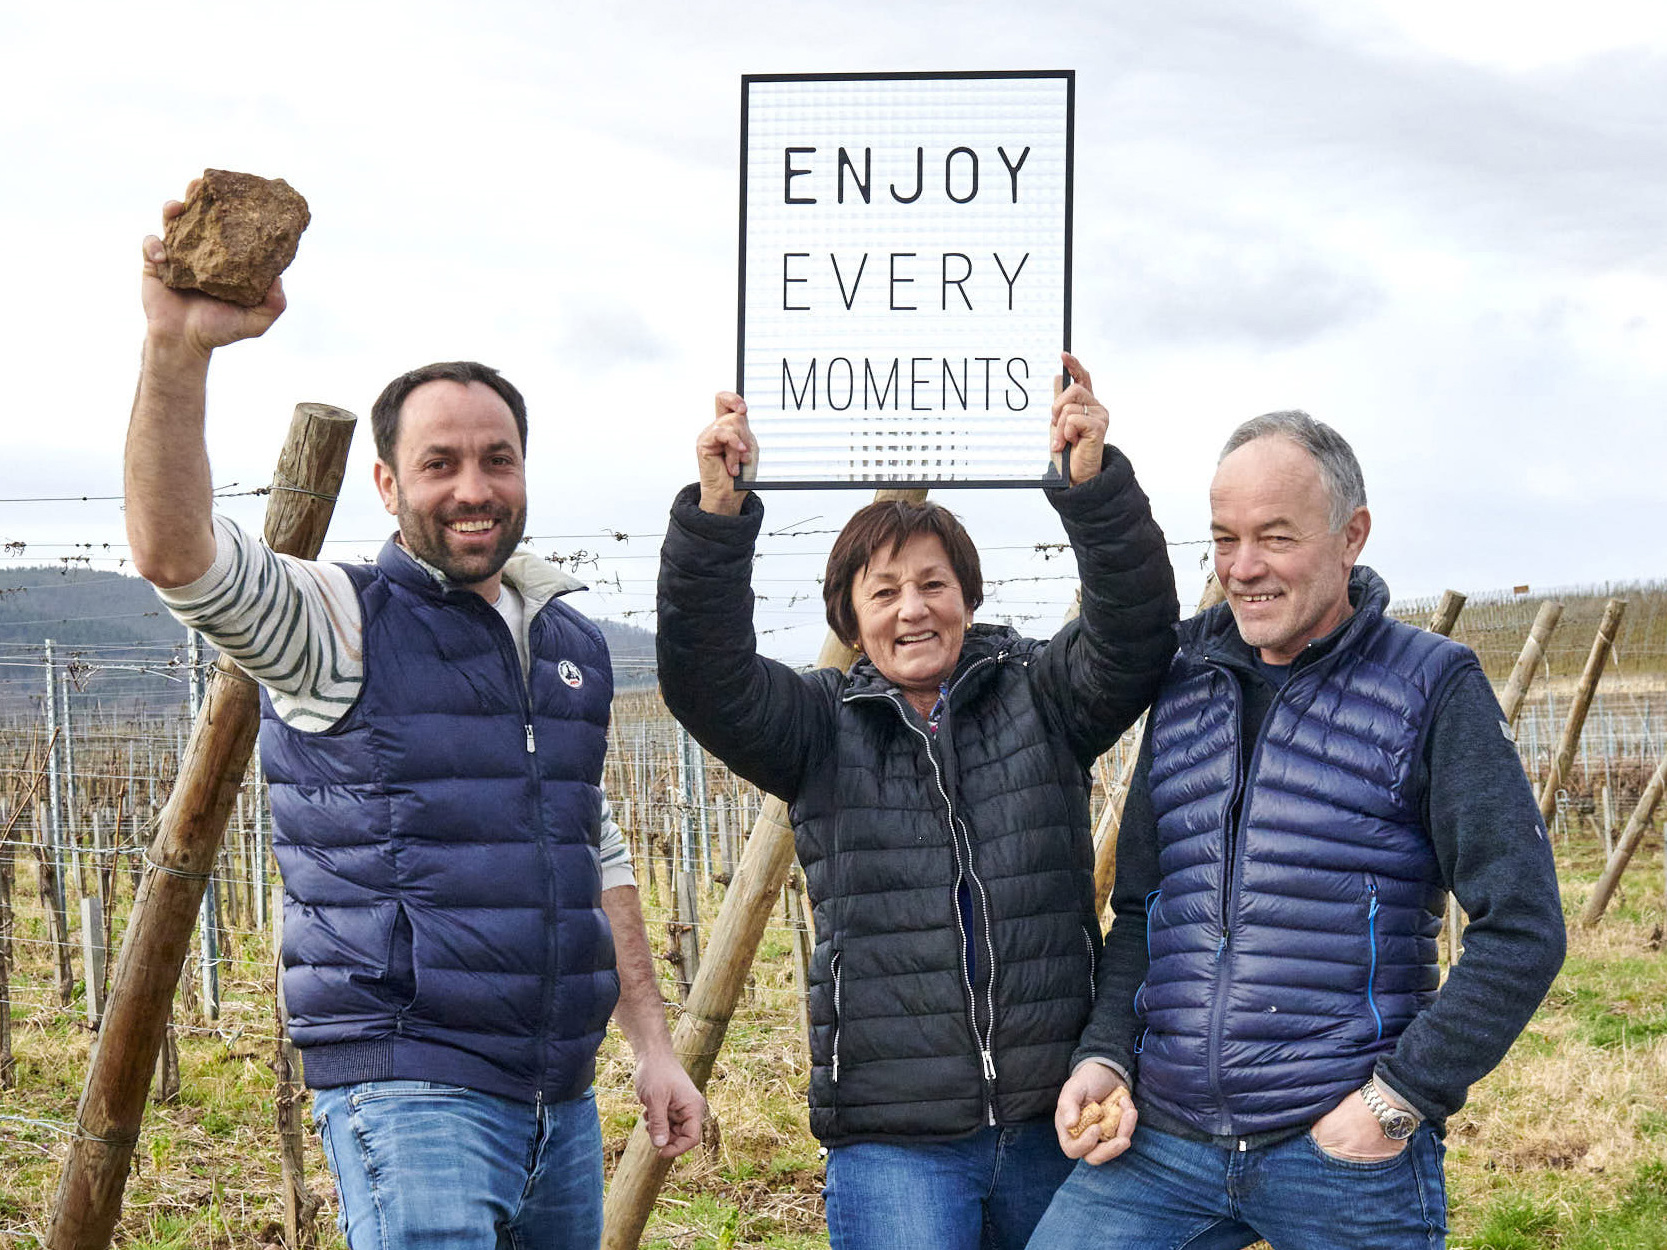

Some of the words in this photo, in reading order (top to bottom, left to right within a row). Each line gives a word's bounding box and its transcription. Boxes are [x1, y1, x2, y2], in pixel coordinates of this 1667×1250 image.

[784, 146, 1031, 205] ENJOY
[783, 252, 1030, 311] EVERY
[782, 357, 1030, 412] MOMENTS
